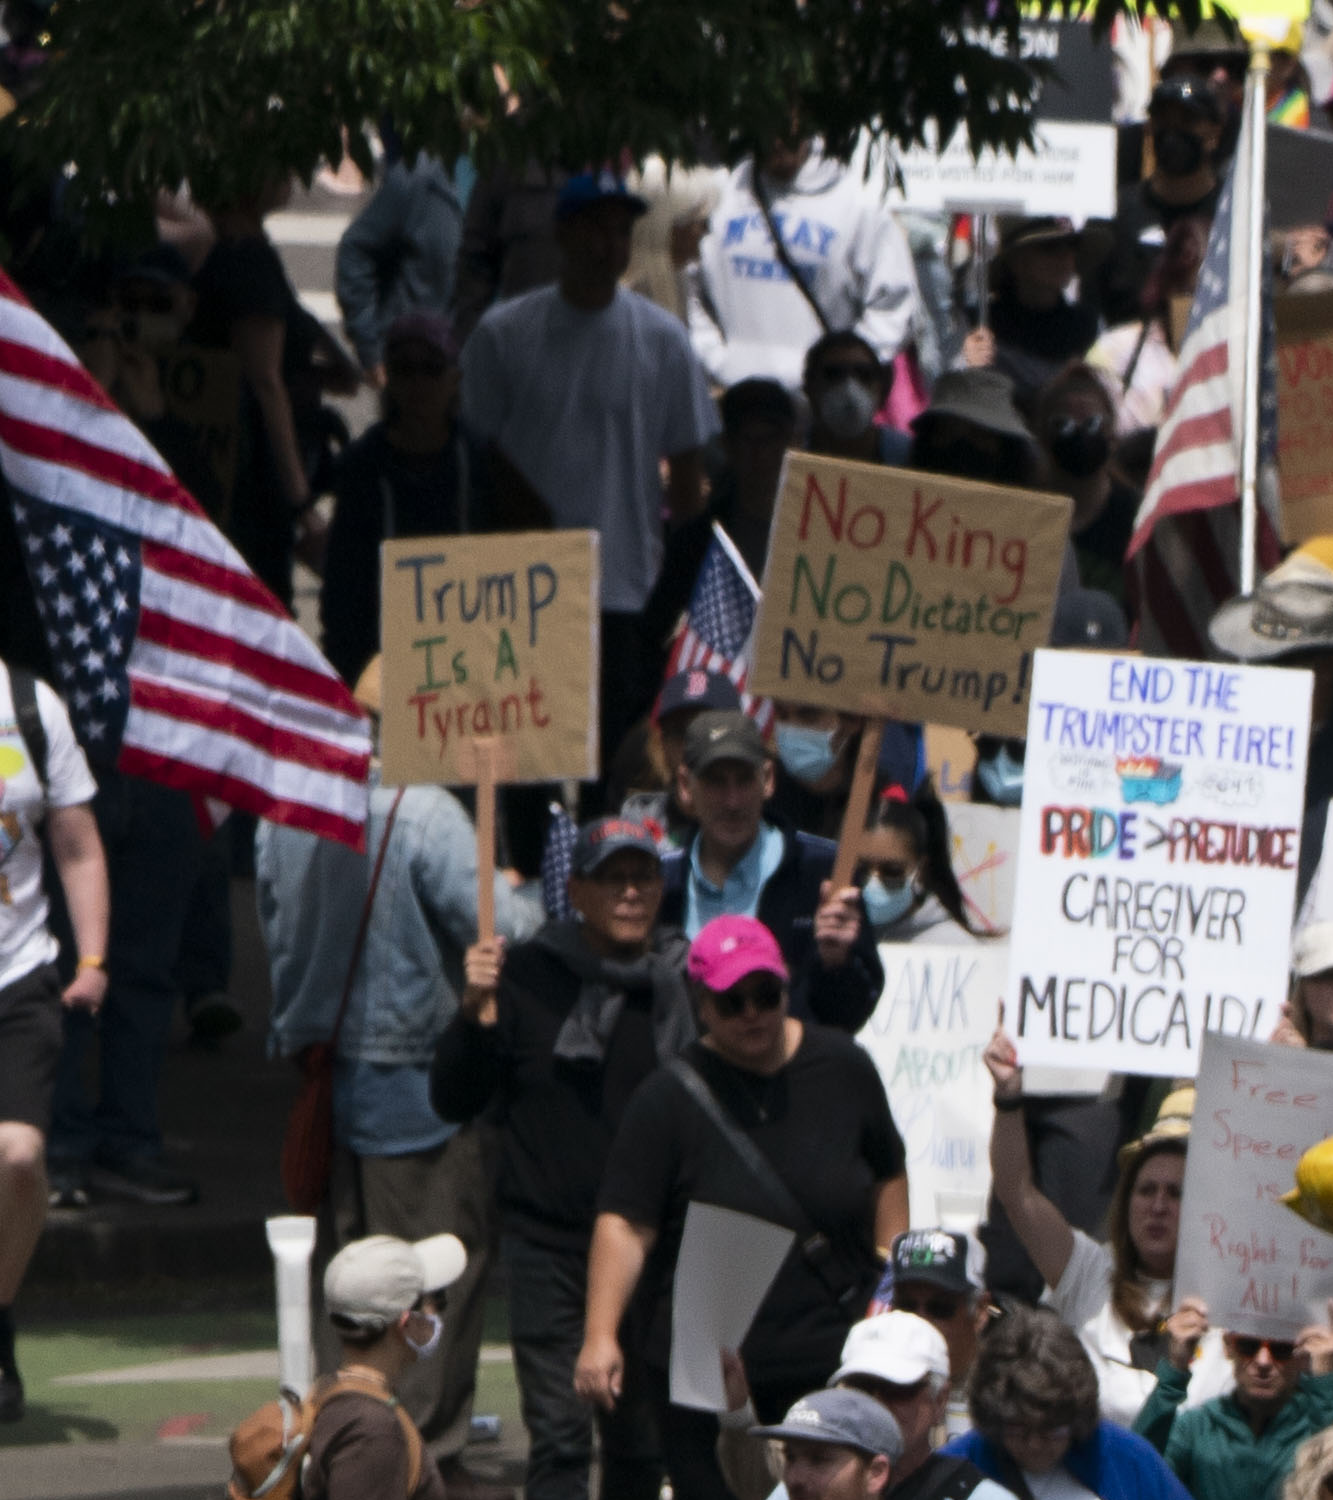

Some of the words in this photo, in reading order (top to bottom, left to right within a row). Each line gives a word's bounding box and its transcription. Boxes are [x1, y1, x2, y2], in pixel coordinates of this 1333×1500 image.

[799, 473, 885, 550] No
[906, 480, 1028, 604] King
[397, 553, 558, 647] Trump
[790, 554, 870, 627] No
[884, 558, 1038, 639] Dictator
[414, 637, 467, 695] Is
[495, 630, 519, 678] A
[1109, 660, 1178, 705] END
[1184, 666, 1243, 713] THE
[411, 678, 551, 759] Tyrant
[1038, 702, 1206, 757] TRUMPSTER
[1216, 719, 1295, 772] FIRE!
[1061, 874, 1247, 944] CAREGIVER
[1112, 937, 1186, 978] FOR
